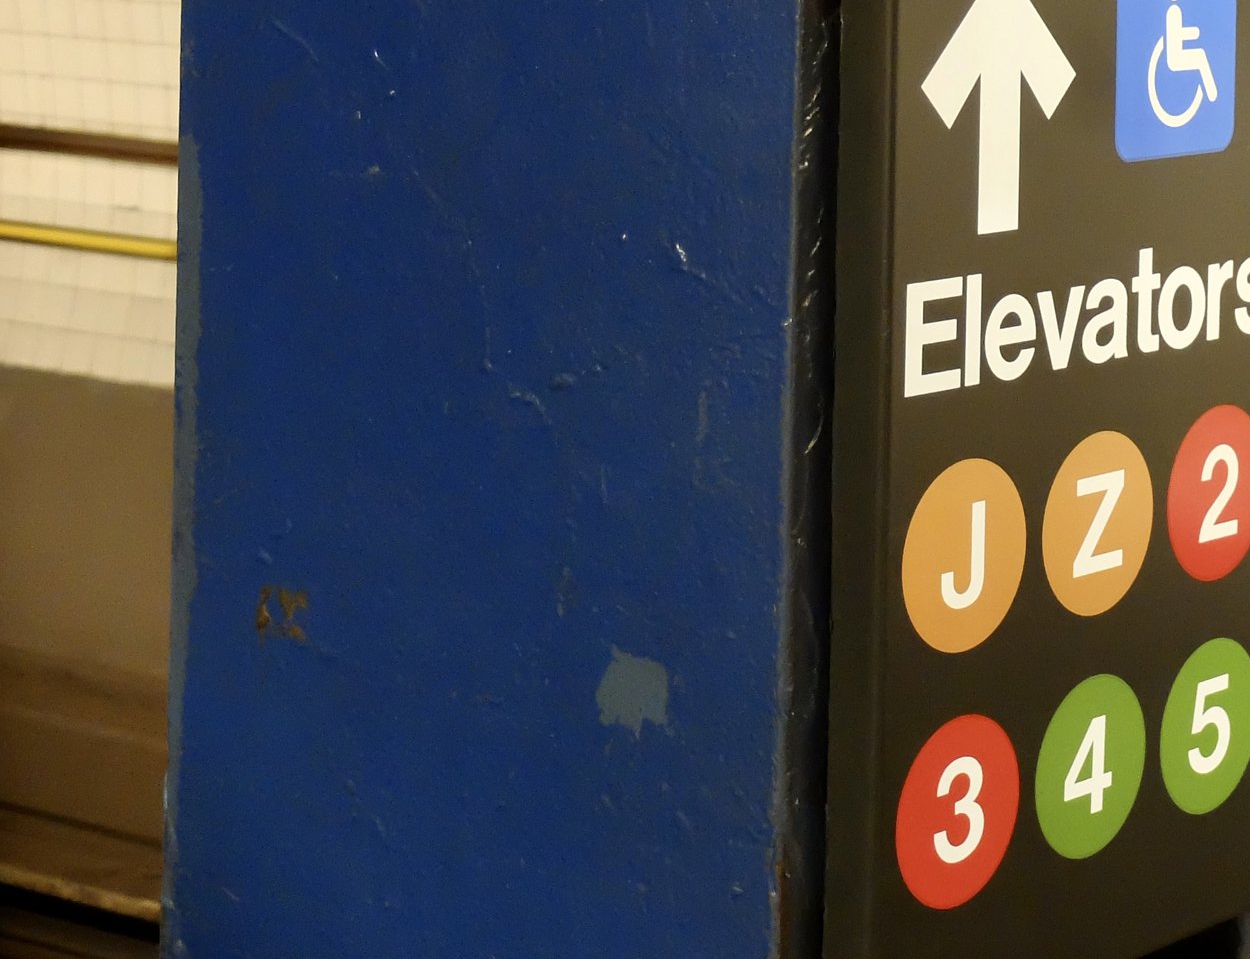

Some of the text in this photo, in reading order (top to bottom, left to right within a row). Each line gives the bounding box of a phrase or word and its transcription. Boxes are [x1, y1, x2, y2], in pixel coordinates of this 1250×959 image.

[940, 442, 1240, 610] J Z 2
[932, 673, 1231, 864] 3 4 5
